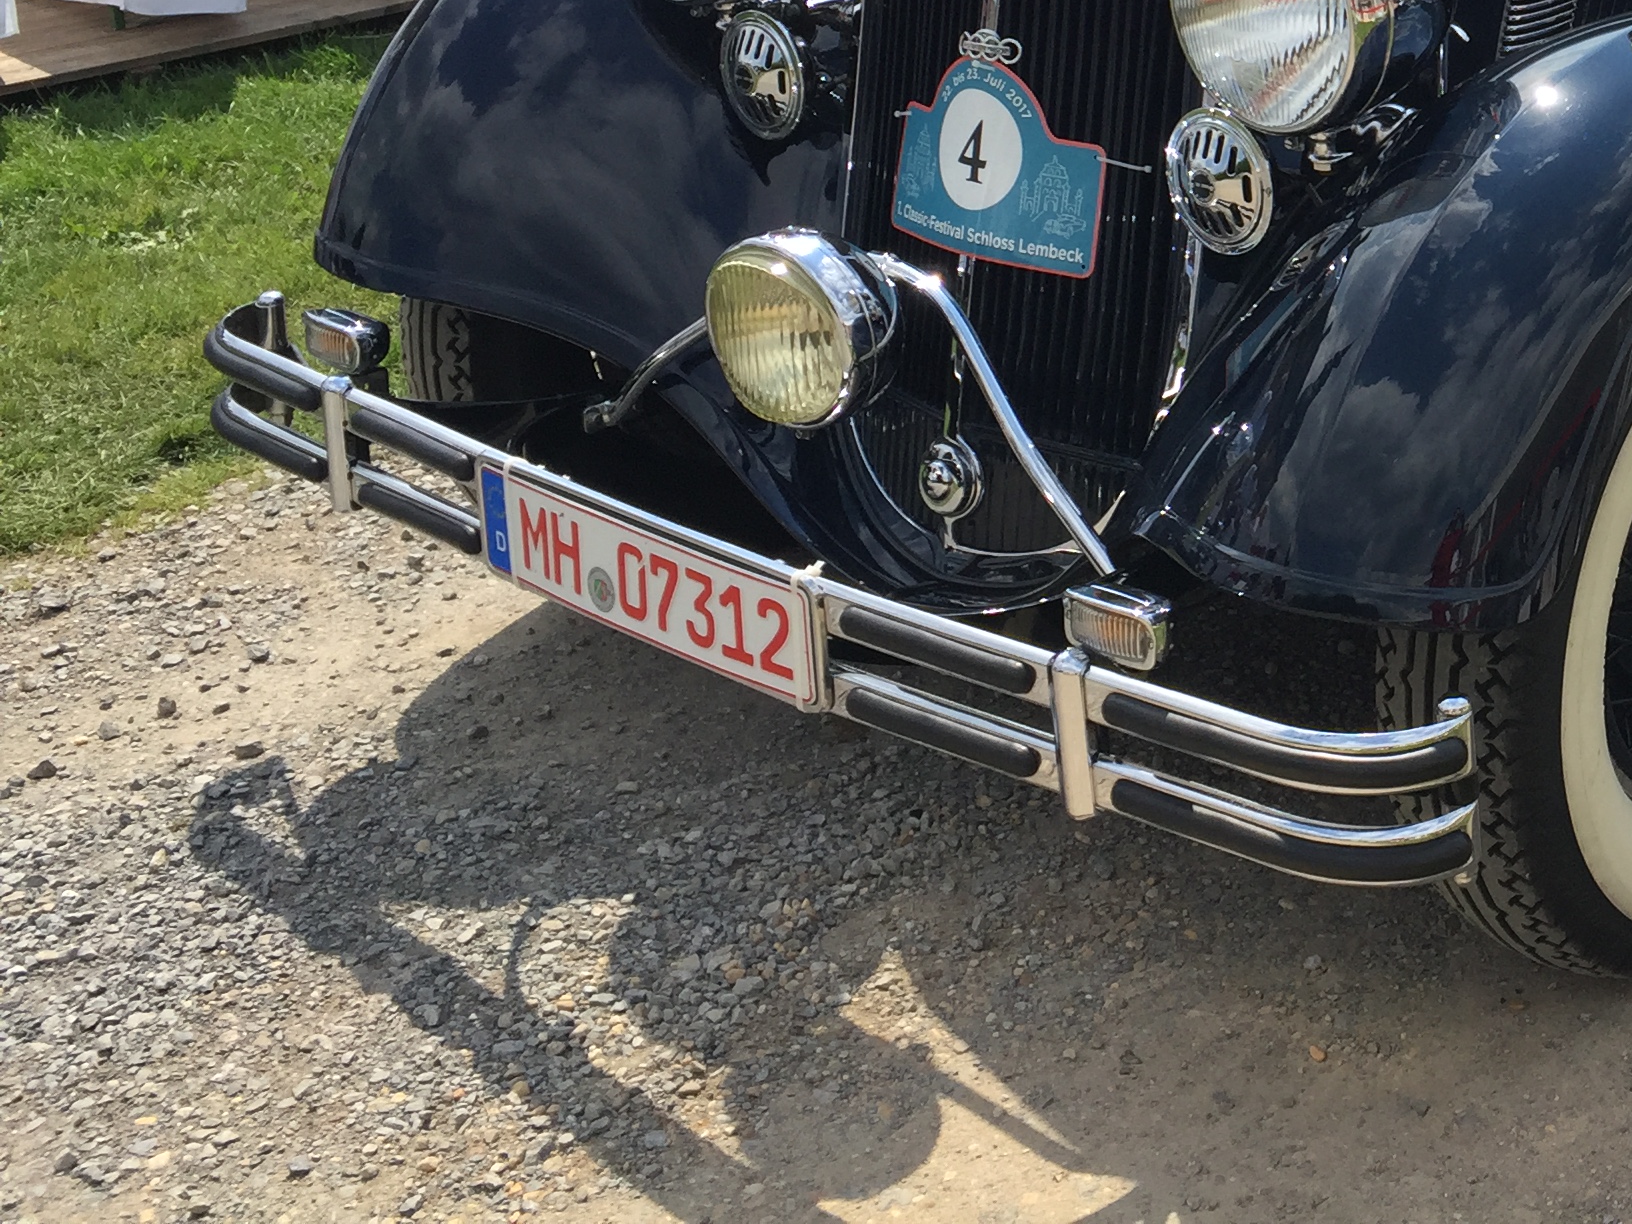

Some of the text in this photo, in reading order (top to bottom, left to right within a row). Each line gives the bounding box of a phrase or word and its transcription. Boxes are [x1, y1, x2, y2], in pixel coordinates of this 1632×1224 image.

[966, 68, 981, 80] 23.
[983, 72, 1007, 92] Juli
[1005, 88, 1033, 118] 2017
[957, 120, 987, 185] 4
[903, 203, 965, 240] Classic-Festival
[966, 227, 1015, 252] Schloss
[1018, 238, 1084, 264] Lembeck
[495, 531, 506, 552] D
[519, 497, 794, 681] MH 07312
